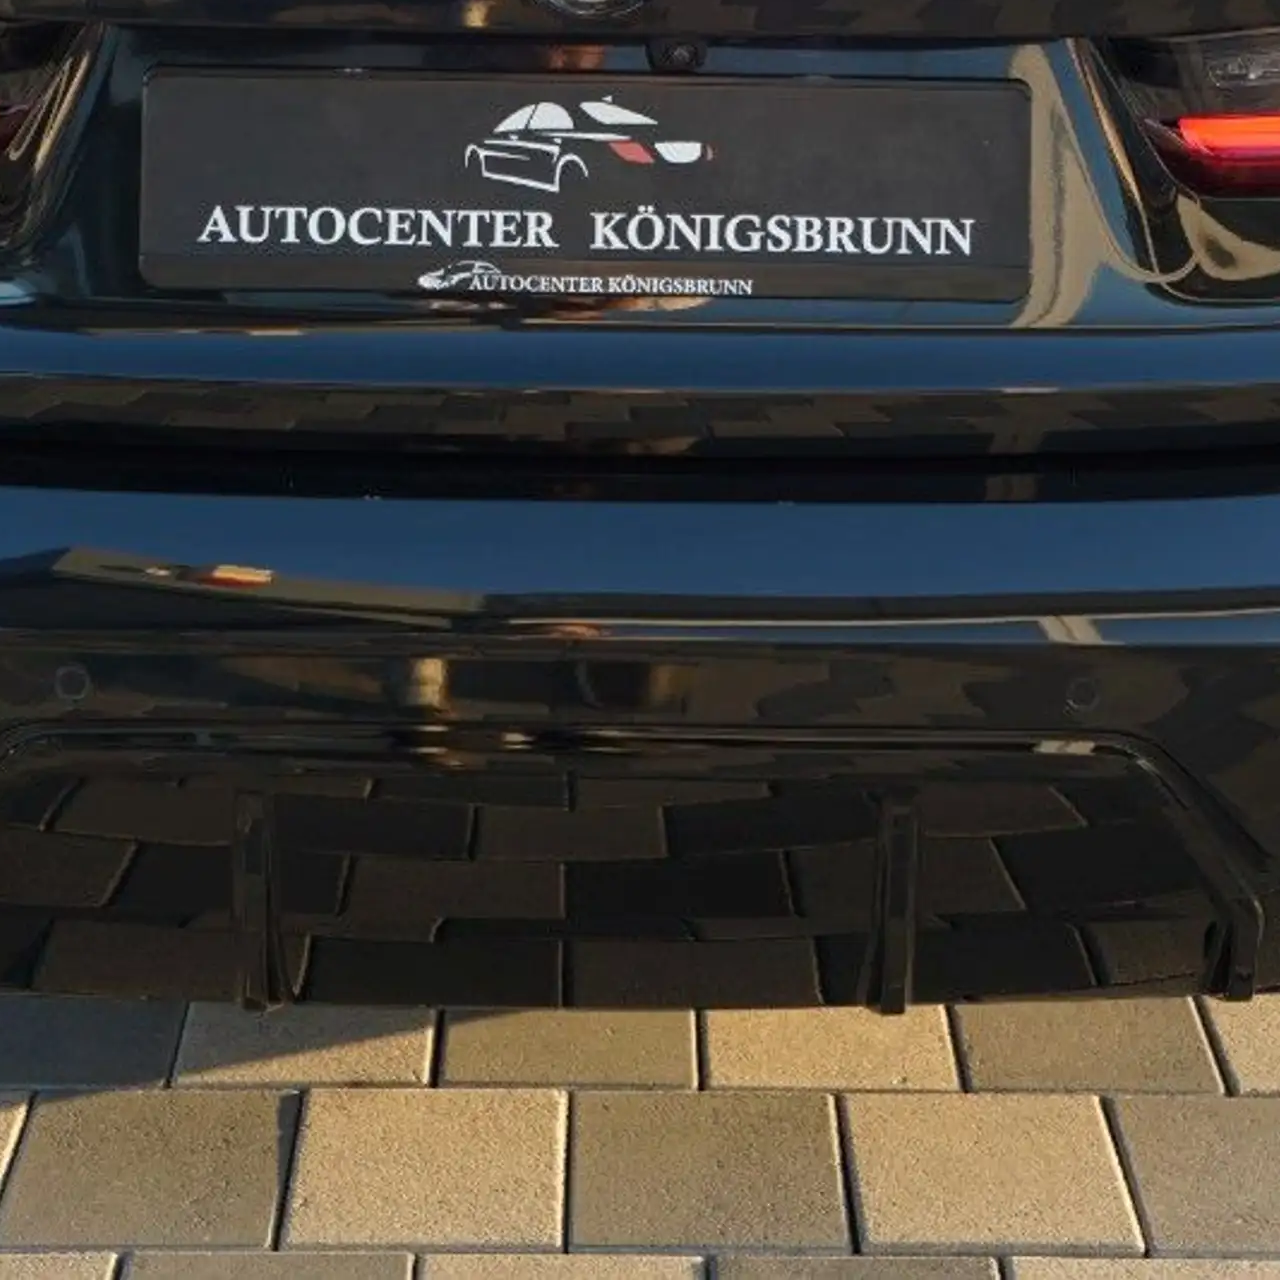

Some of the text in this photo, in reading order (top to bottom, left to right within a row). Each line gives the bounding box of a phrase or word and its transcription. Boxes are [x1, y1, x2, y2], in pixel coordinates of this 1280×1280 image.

[196, 204, 975, 257] AUTOCENTER KÖNIGSBRUNN
[469, 273, 754, 297] AUTOCENTER KÖNIGSBRUNN
